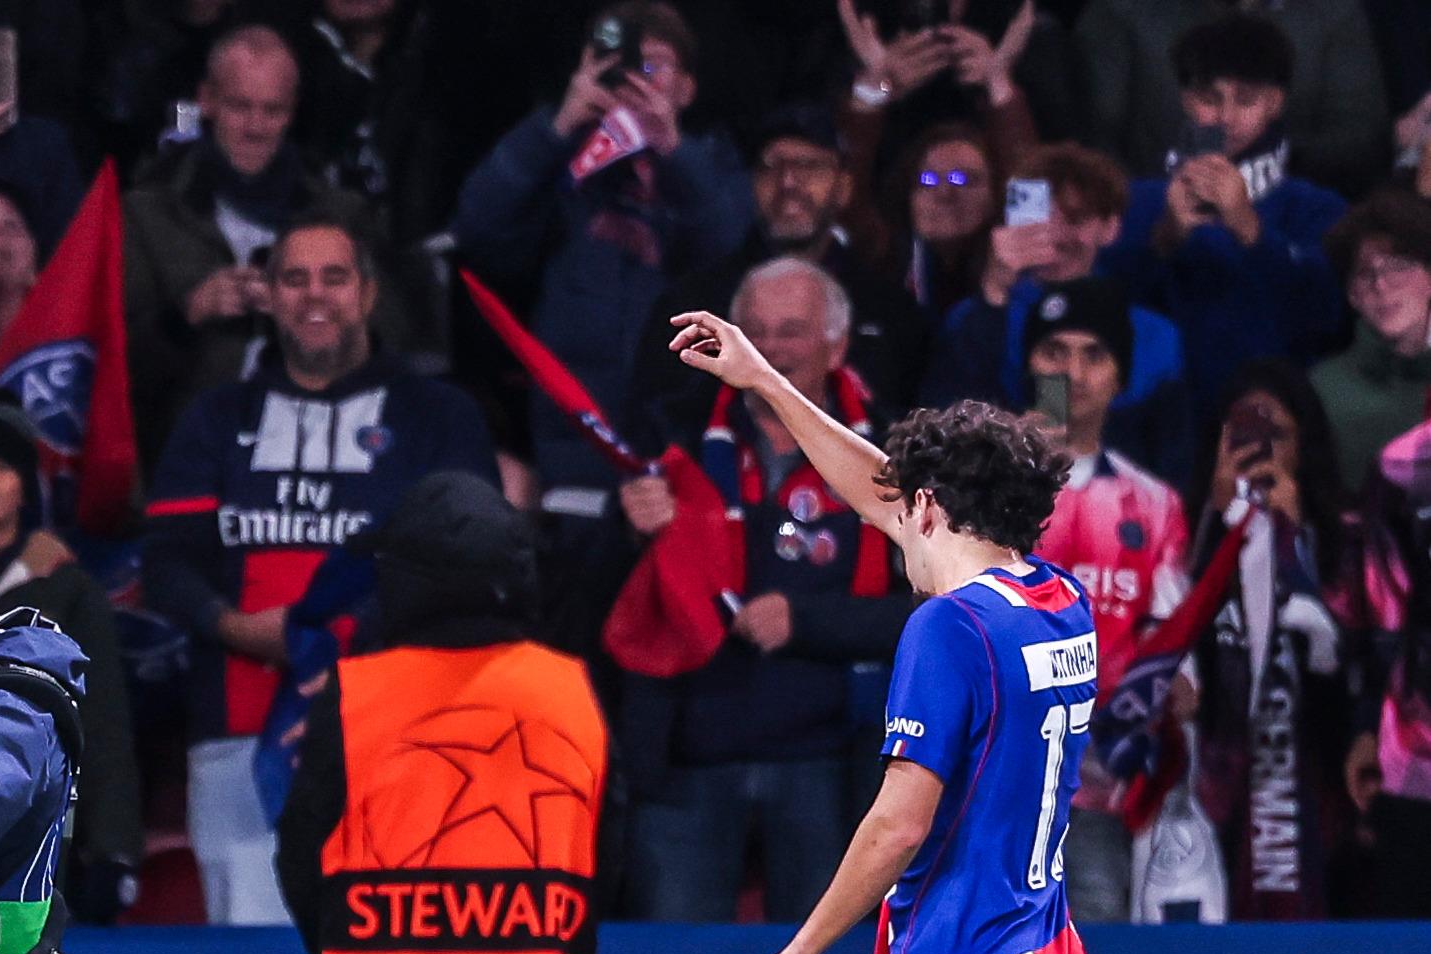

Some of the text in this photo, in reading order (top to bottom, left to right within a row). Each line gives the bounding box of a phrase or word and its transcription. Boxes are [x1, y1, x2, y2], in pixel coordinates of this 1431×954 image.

[276, 475, 332, 511] Fly
[218, 504, 371, 547] Emirate
[1072, 563, 1140, 601] RIS
[346, 881, 588, 942] STEWARD
